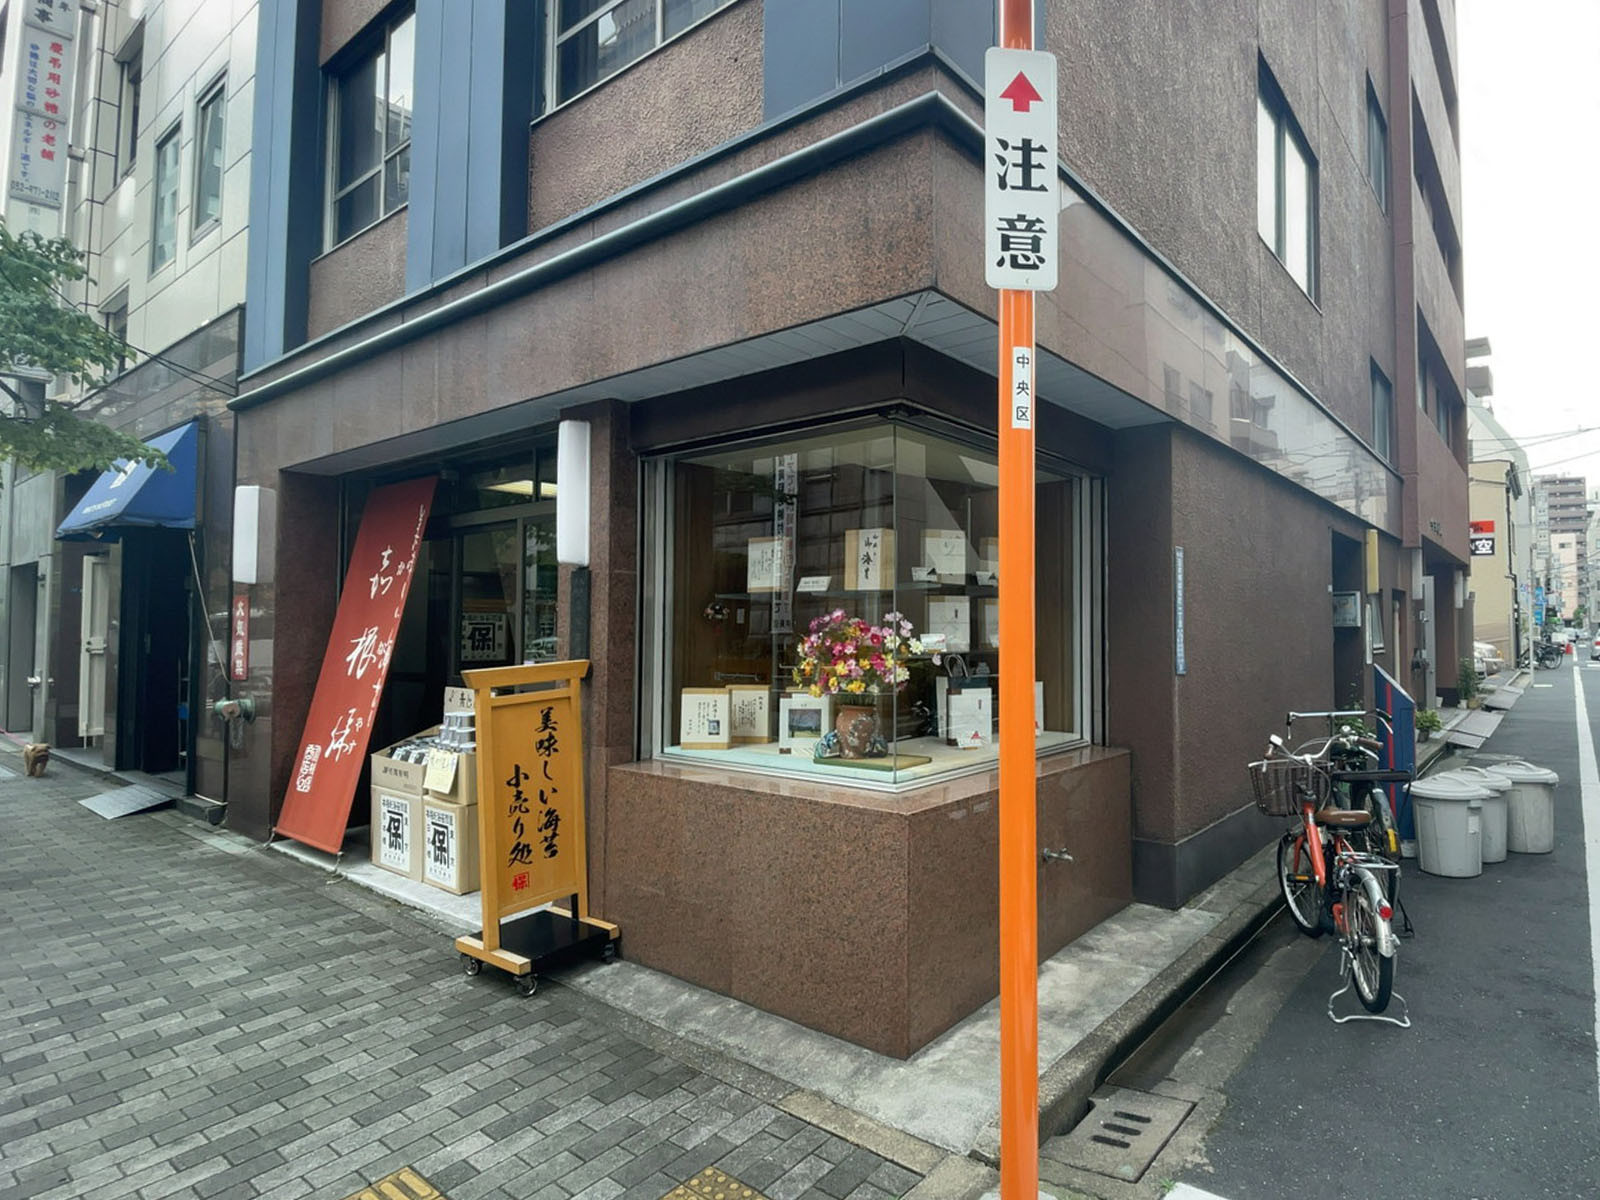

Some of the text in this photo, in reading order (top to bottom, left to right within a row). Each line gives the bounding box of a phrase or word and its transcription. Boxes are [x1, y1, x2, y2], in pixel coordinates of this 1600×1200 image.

[995, 137, 1048, 270] 注意
[1016, 353, 1030, 422] 中央区
[467, 626, 492, 651] 保
[506, 763, 533, 868] 小売り処
[534, 706, 561, 860] 美味しい海苔
[386, 815, 402, 851] 保
[431, 827, 448, 866] 保
